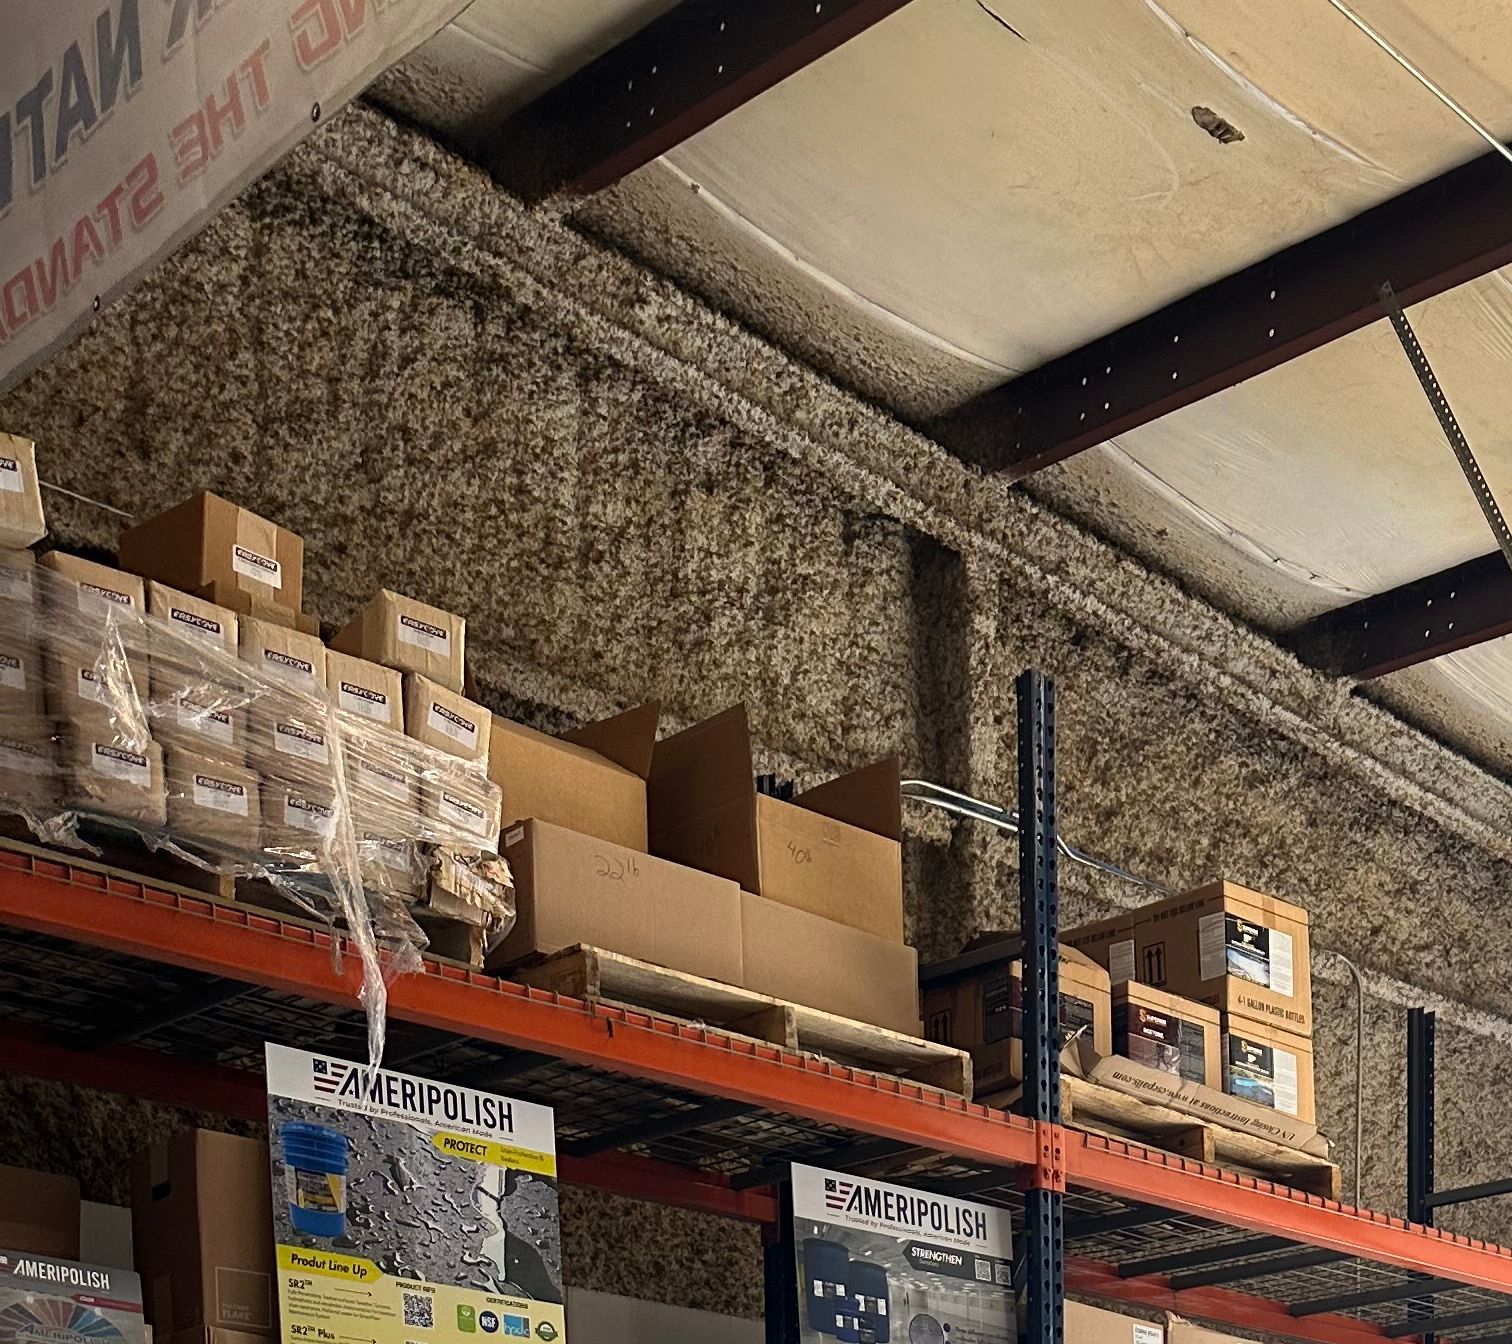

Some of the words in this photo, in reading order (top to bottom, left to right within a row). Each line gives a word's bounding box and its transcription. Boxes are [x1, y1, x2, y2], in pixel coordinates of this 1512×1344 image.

[1247, 998, 1265, 1012] GALLON
[1265, 1004, 1284, 1017] PLASTIC
[1285, 1010, 1305, 1024] BOTTLES
[338, 1067, 515, 1133] AMERIPOLISH
[1189, 1098, 1200, 1108] at
[1199, 1101, 1251, 1127] Instructions
[1250, 1119, 1281, 1136] Closing
[443, 1138, 488, 1156] PROTECT
[846, 1184, 988, 1241] AMERIPOLISH
[291, 1253, 326, 1270] Produt
[329, 1260, 350, 1273] Line
[352, 1264, 368, 1279] Up
[911, 1247, 963, 1266] STRENGTHEN
[13, 1259, 111, 1291] AMERIPOLISH
[317, 1328, 336, 1340] Plus
